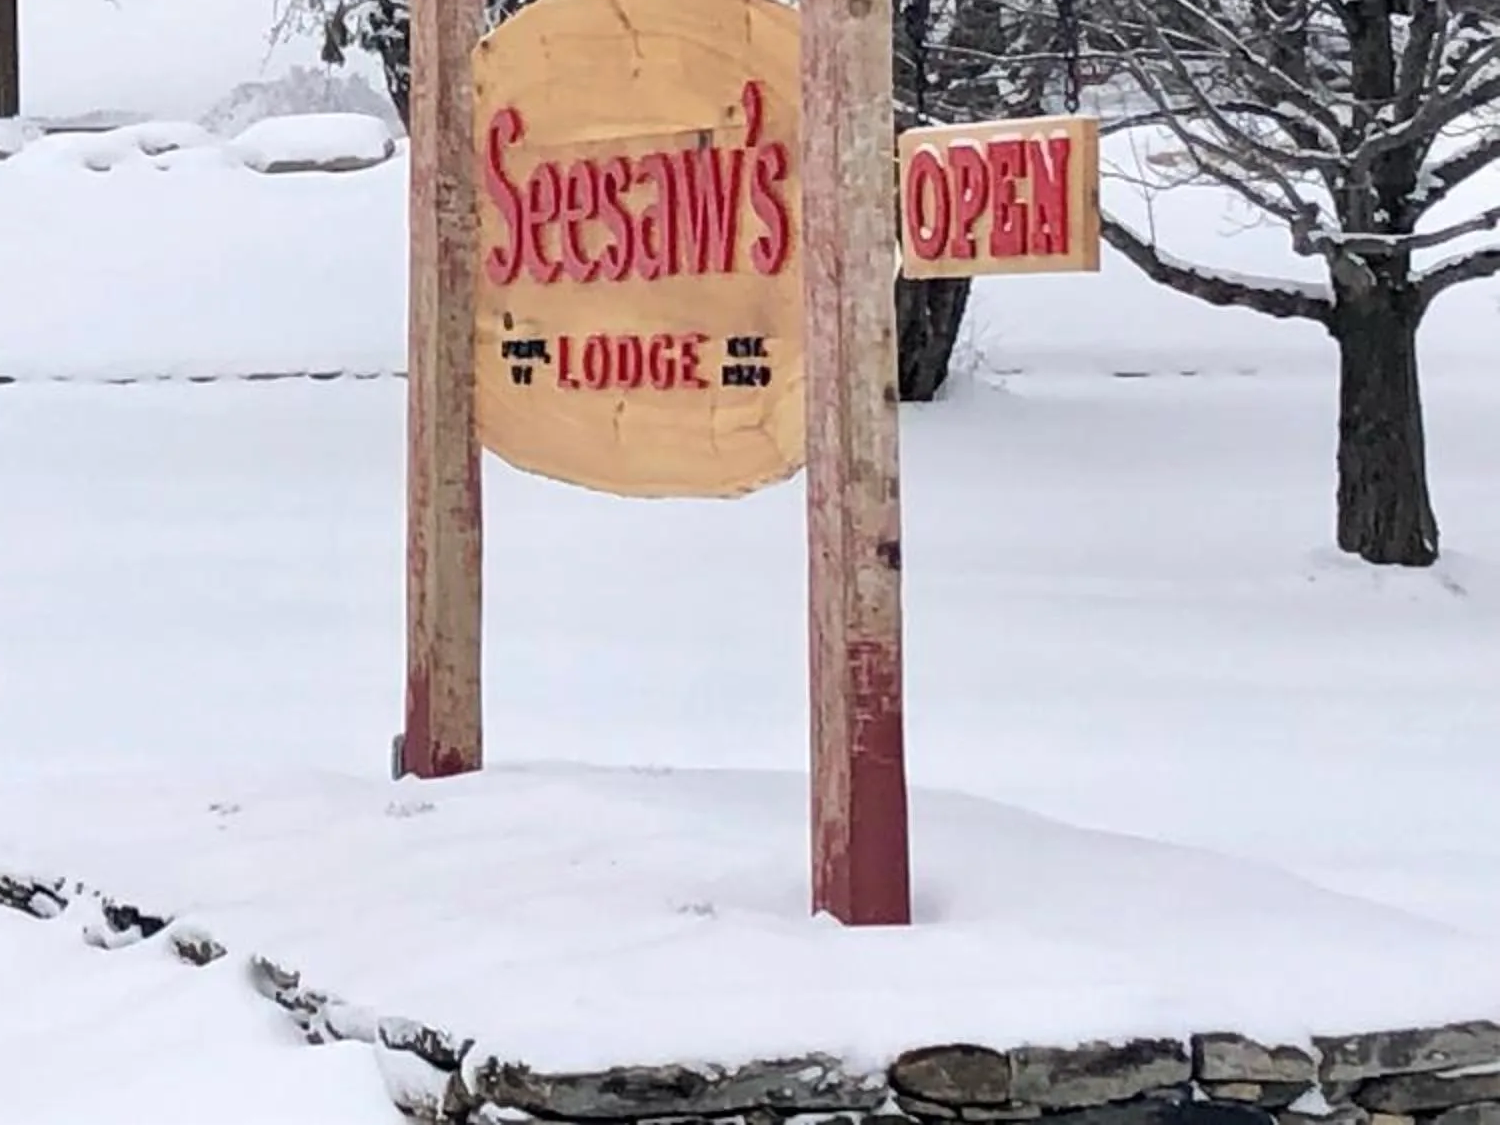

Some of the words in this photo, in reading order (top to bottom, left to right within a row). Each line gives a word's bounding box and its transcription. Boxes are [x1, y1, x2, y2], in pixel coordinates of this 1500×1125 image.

[485, 80, 791, 285] Seesaw's
[906, 135, 1071, 261] OPEN
[557, 333, 710, 390] LODGE
